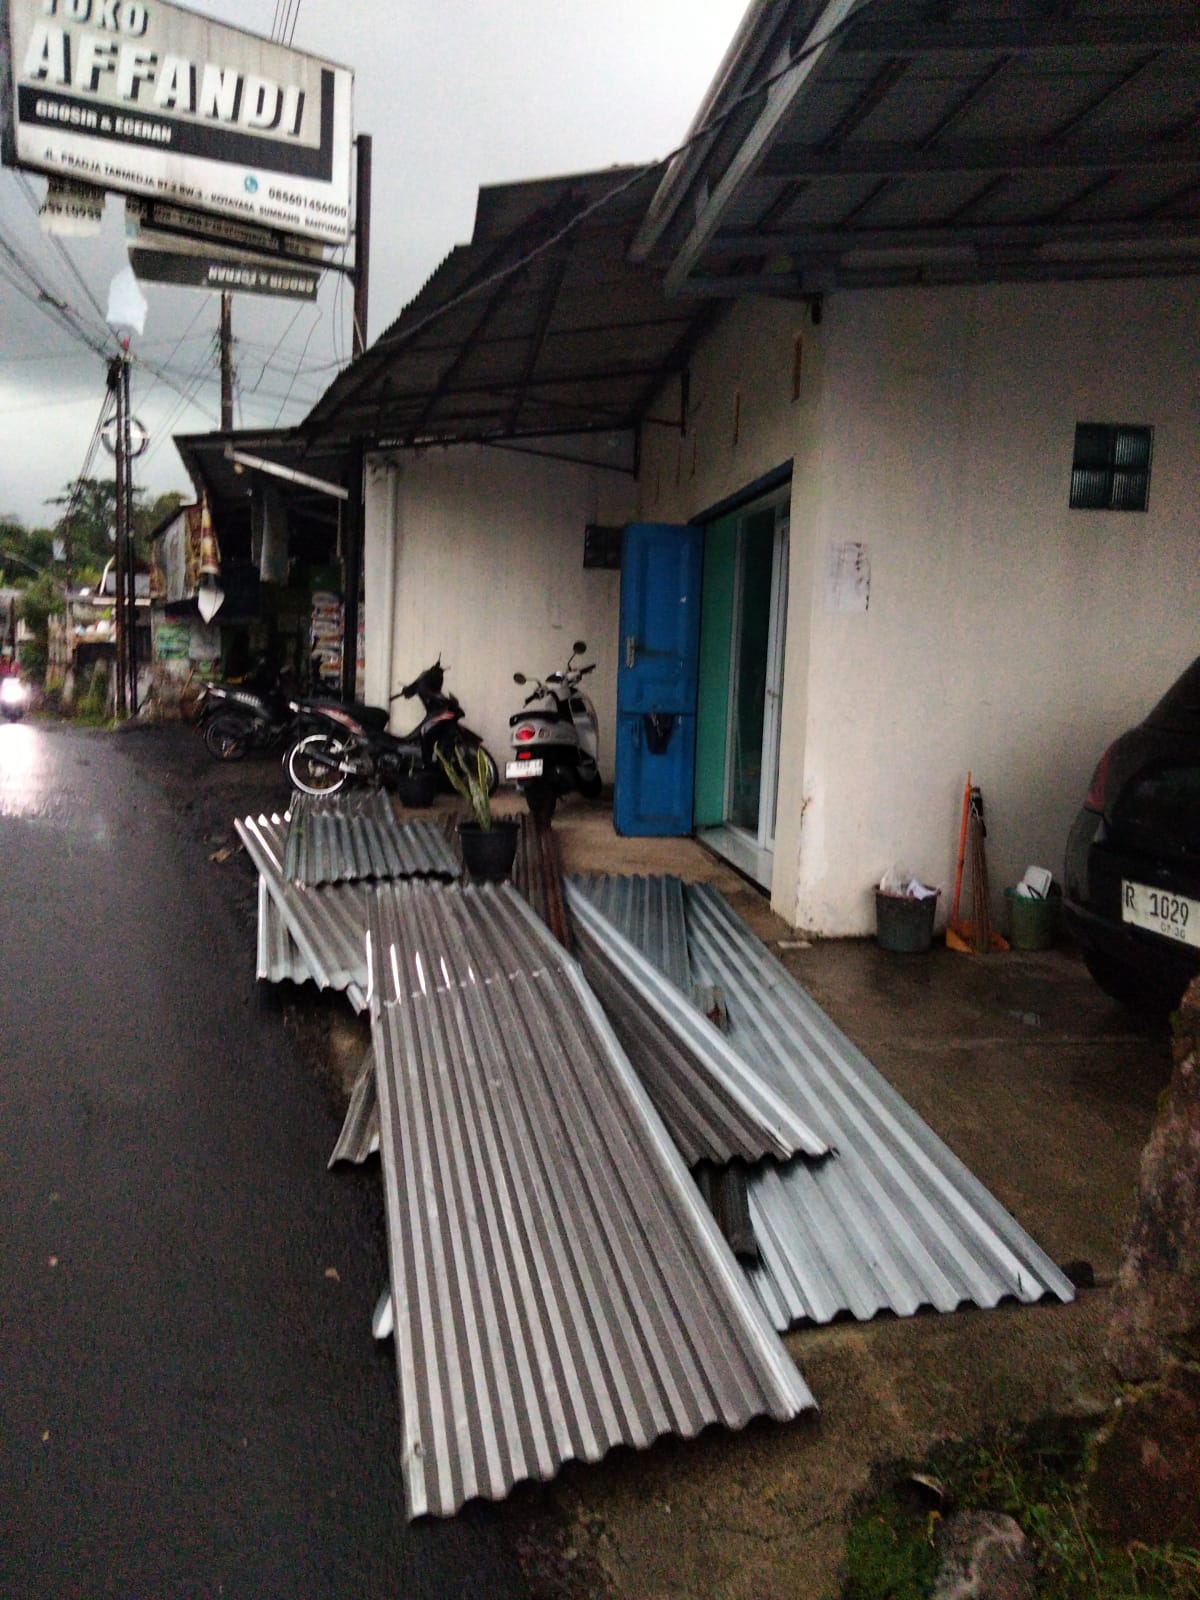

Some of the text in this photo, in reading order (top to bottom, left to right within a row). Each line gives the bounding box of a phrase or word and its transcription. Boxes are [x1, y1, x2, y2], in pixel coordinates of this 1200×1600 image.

[22, 22, 305, 137] AFFANDI
[1125, 884, 1189, 927] R 1029
